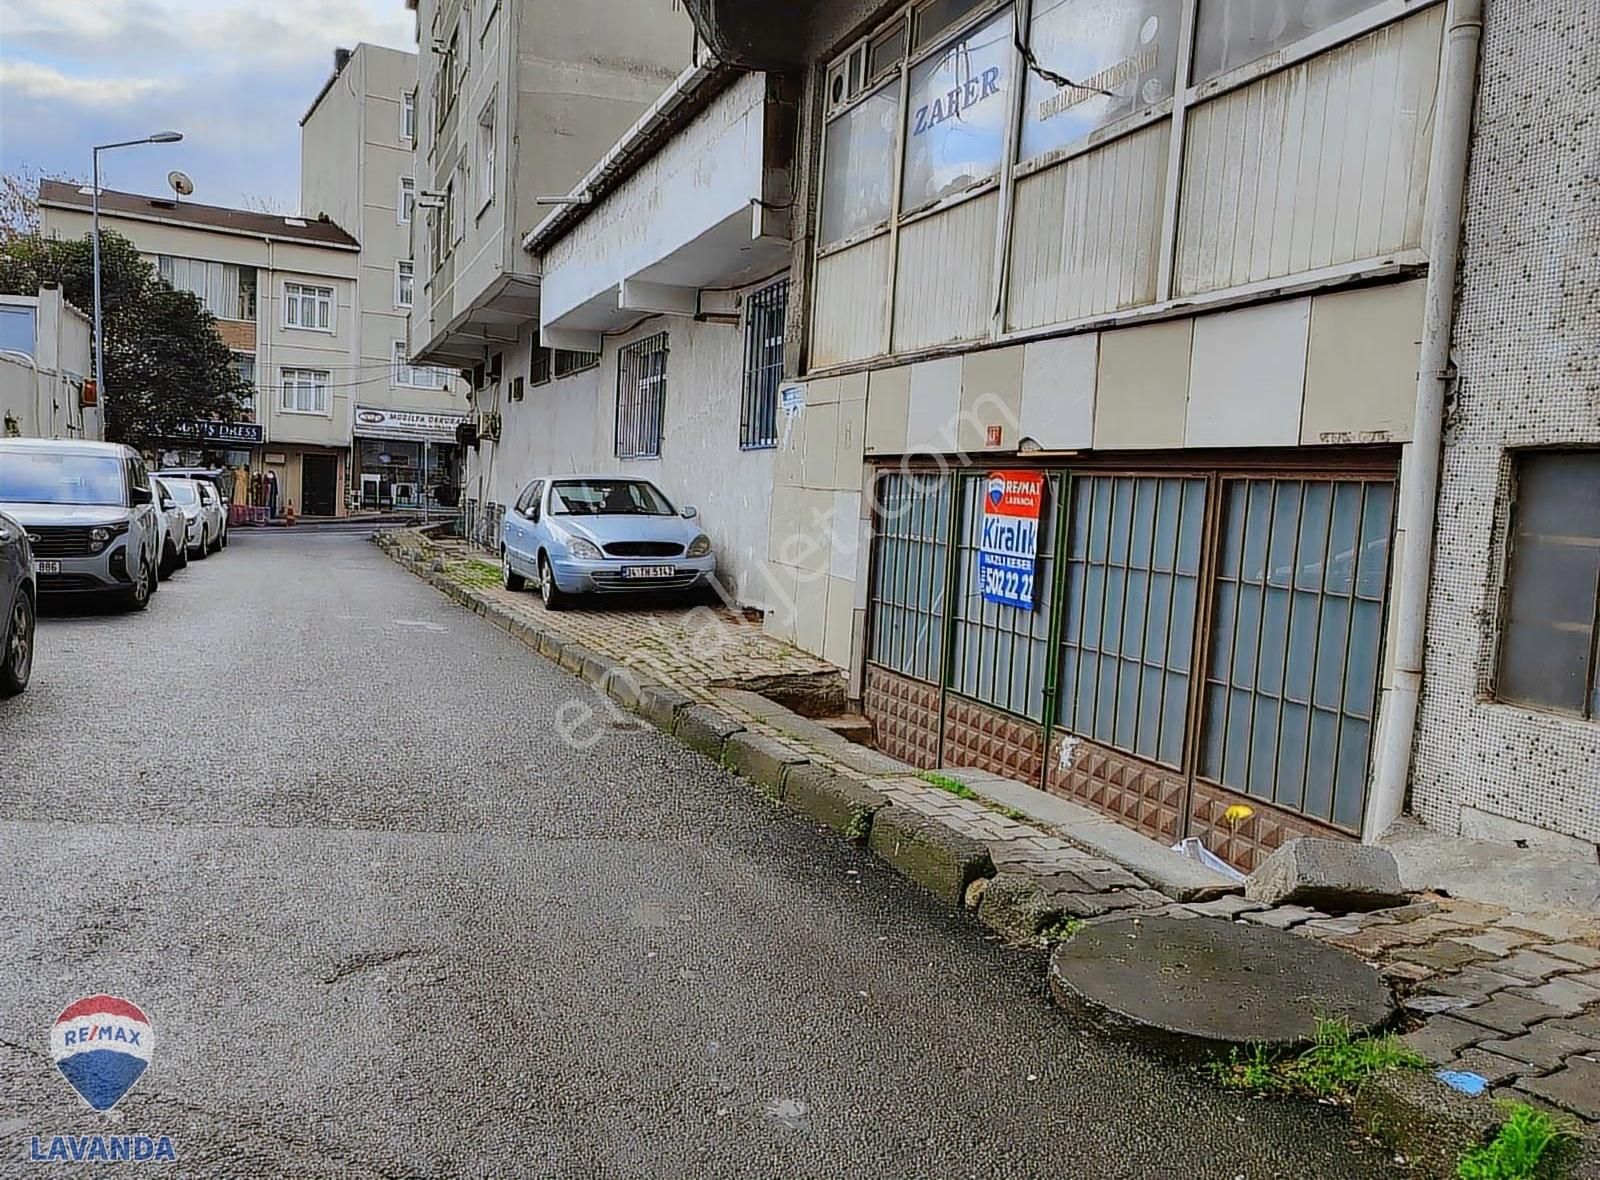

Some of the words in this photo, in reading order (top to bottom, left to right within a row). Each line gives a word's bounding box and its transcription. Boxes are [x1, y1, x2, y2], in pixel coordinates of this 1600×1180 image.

[913, 66, 1000, 136] ZAFER
[219, 425, 258, 438] DRESS
[982, 516, 1036, 555] Kiralık
[986, 567, 1005, 597] 502
[1005, 571, 1019, 599] 22
